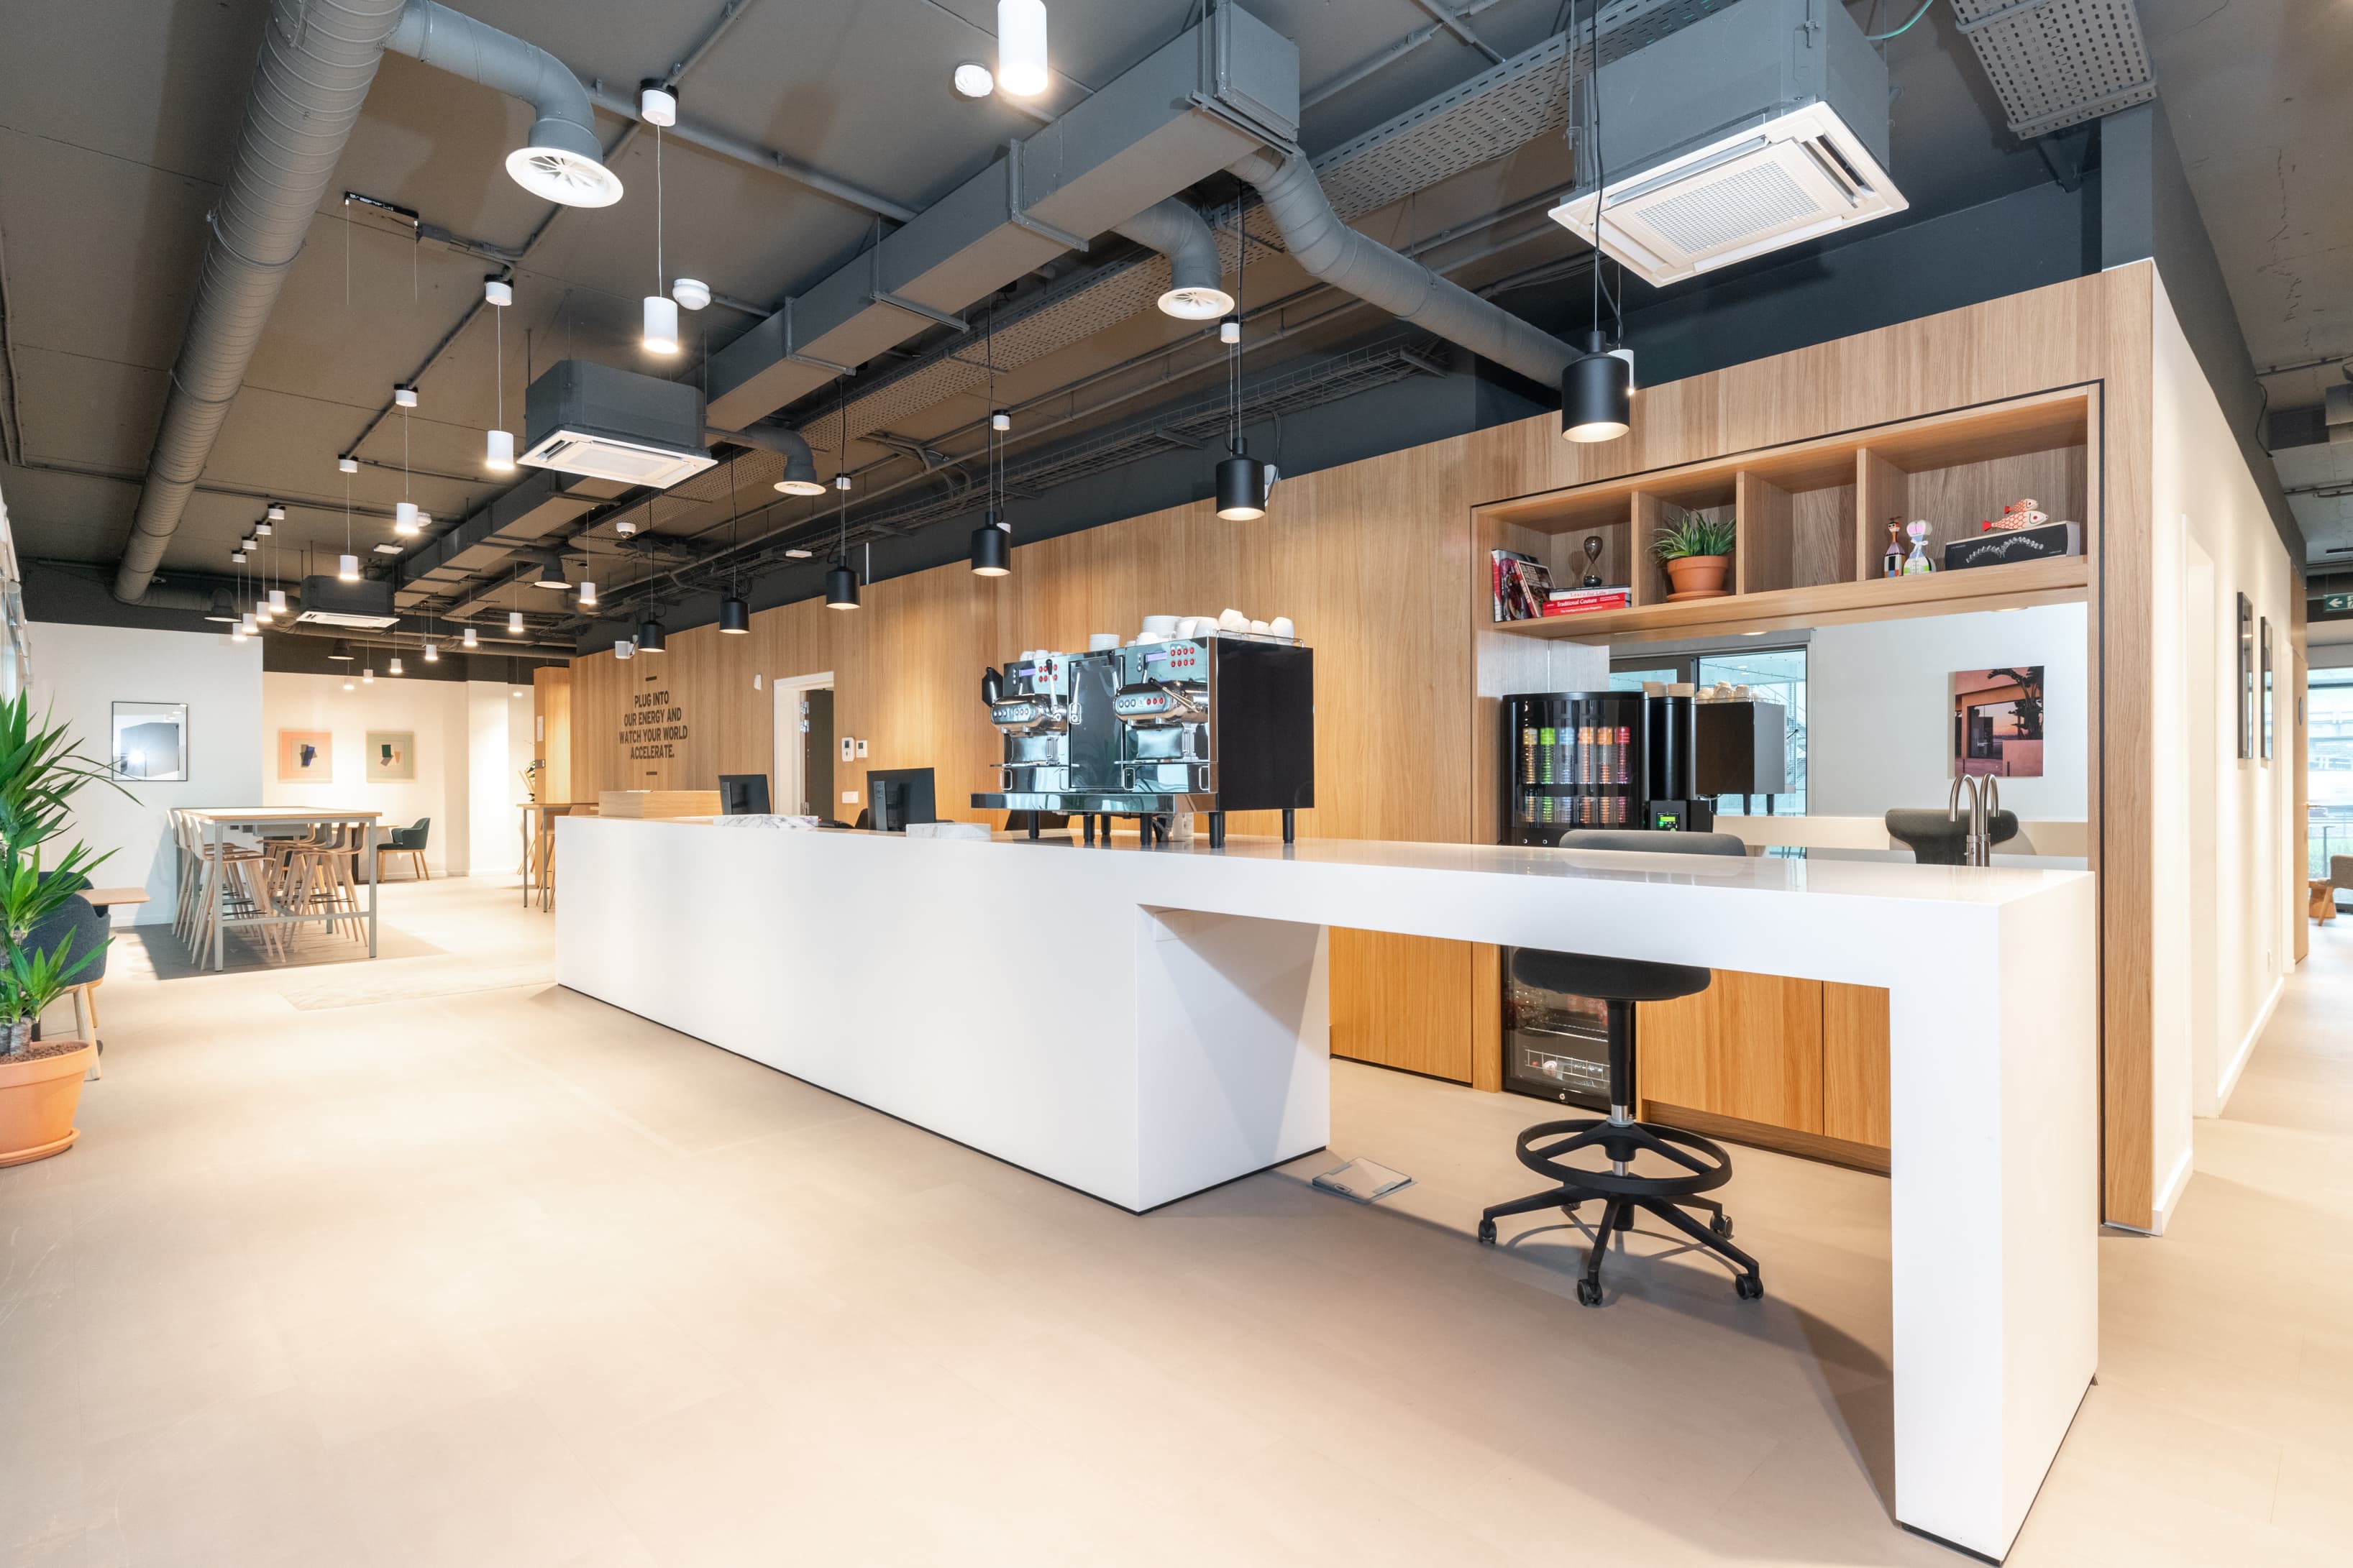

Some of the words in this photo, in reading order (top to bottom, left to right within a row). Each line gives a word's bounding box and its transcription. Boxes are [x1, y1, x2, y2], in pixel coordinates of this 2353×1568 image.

[634, 693, 652, 708] PLUG
[653, 690, 669, 706] INTO
[623, 712, 637, 727] OUR
[638, 709, 665, 725] ENERGY
[667, 707, 682, 723] AND
[619, 730, 641, 744] WATCH
[642, 728, 661, 742] YOUR
[662, 725, 688, 741] WORLD
[630, 743, 675, 760] ACCELERATE.
